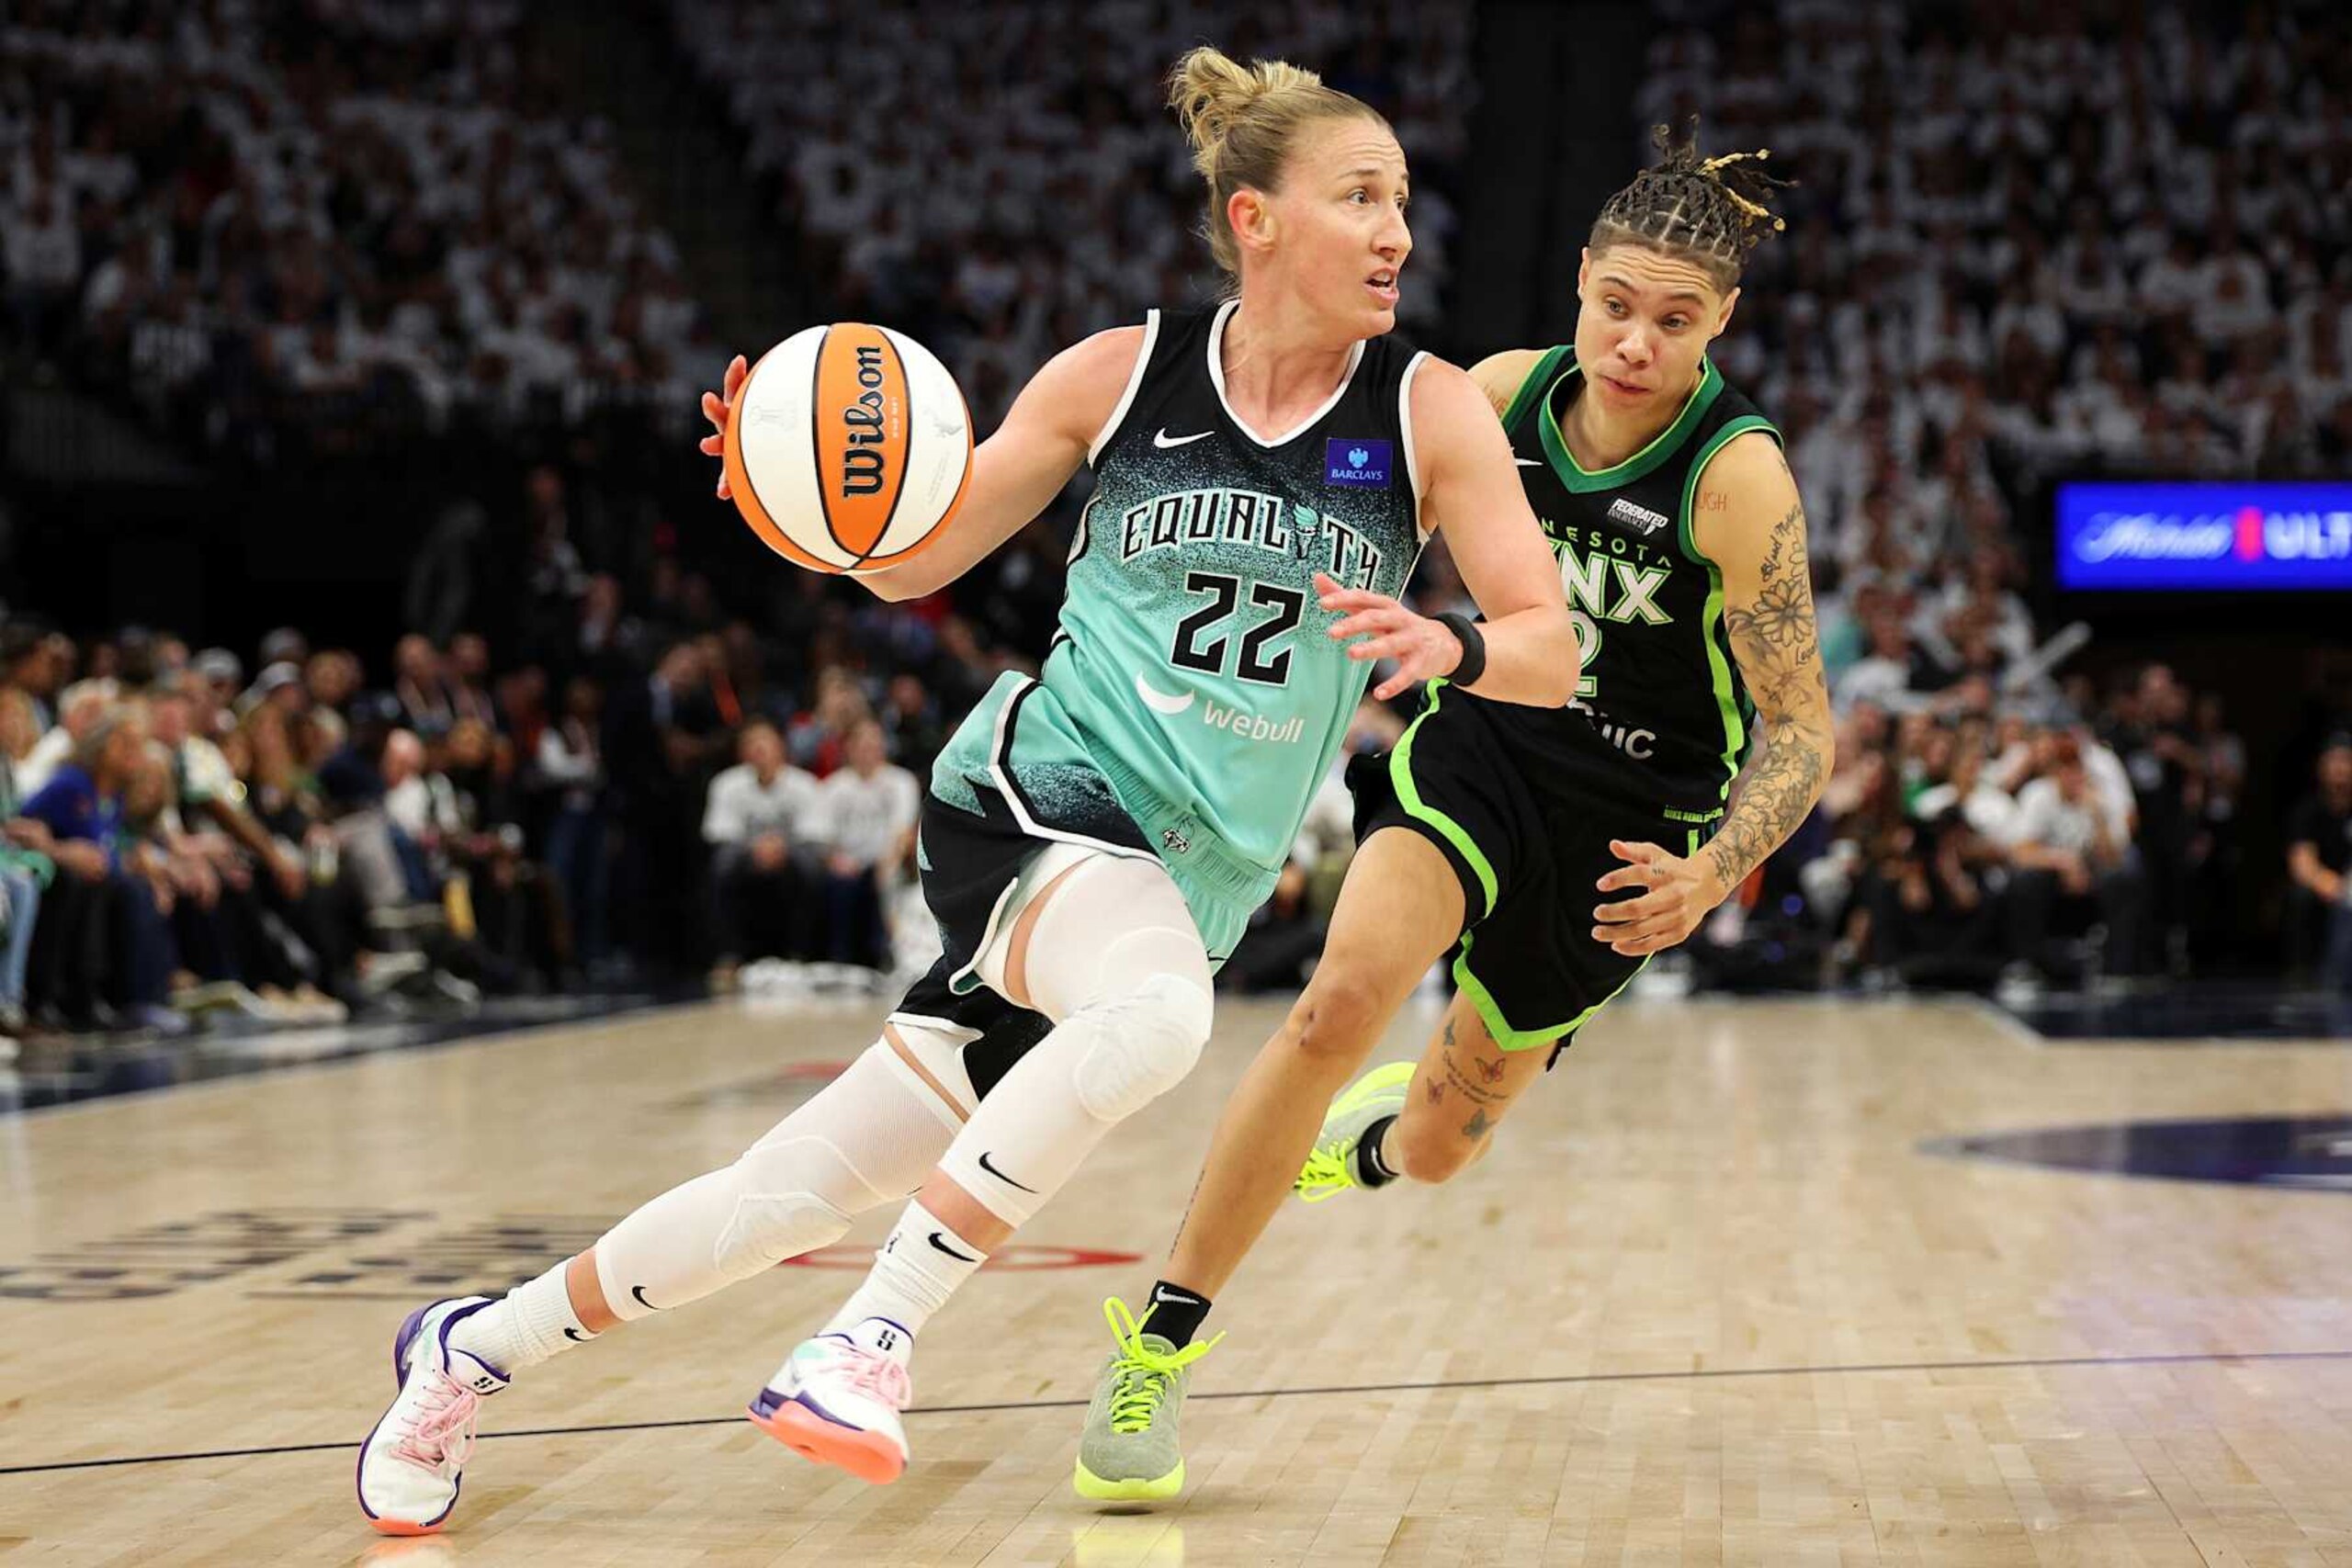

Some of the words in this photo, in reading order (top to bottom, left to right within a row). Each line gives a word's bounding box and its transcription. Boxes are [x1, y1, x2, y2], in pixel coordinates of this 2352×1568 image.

[842, 344, 885, 498] Wilson
[1330, 468, 1384, 481] BARCLAYS
[1612, 498, 1668, 528] FEDERATED
[1547, 536, 1674, 626] NX
[1170, 571, 1306, 686] 22
